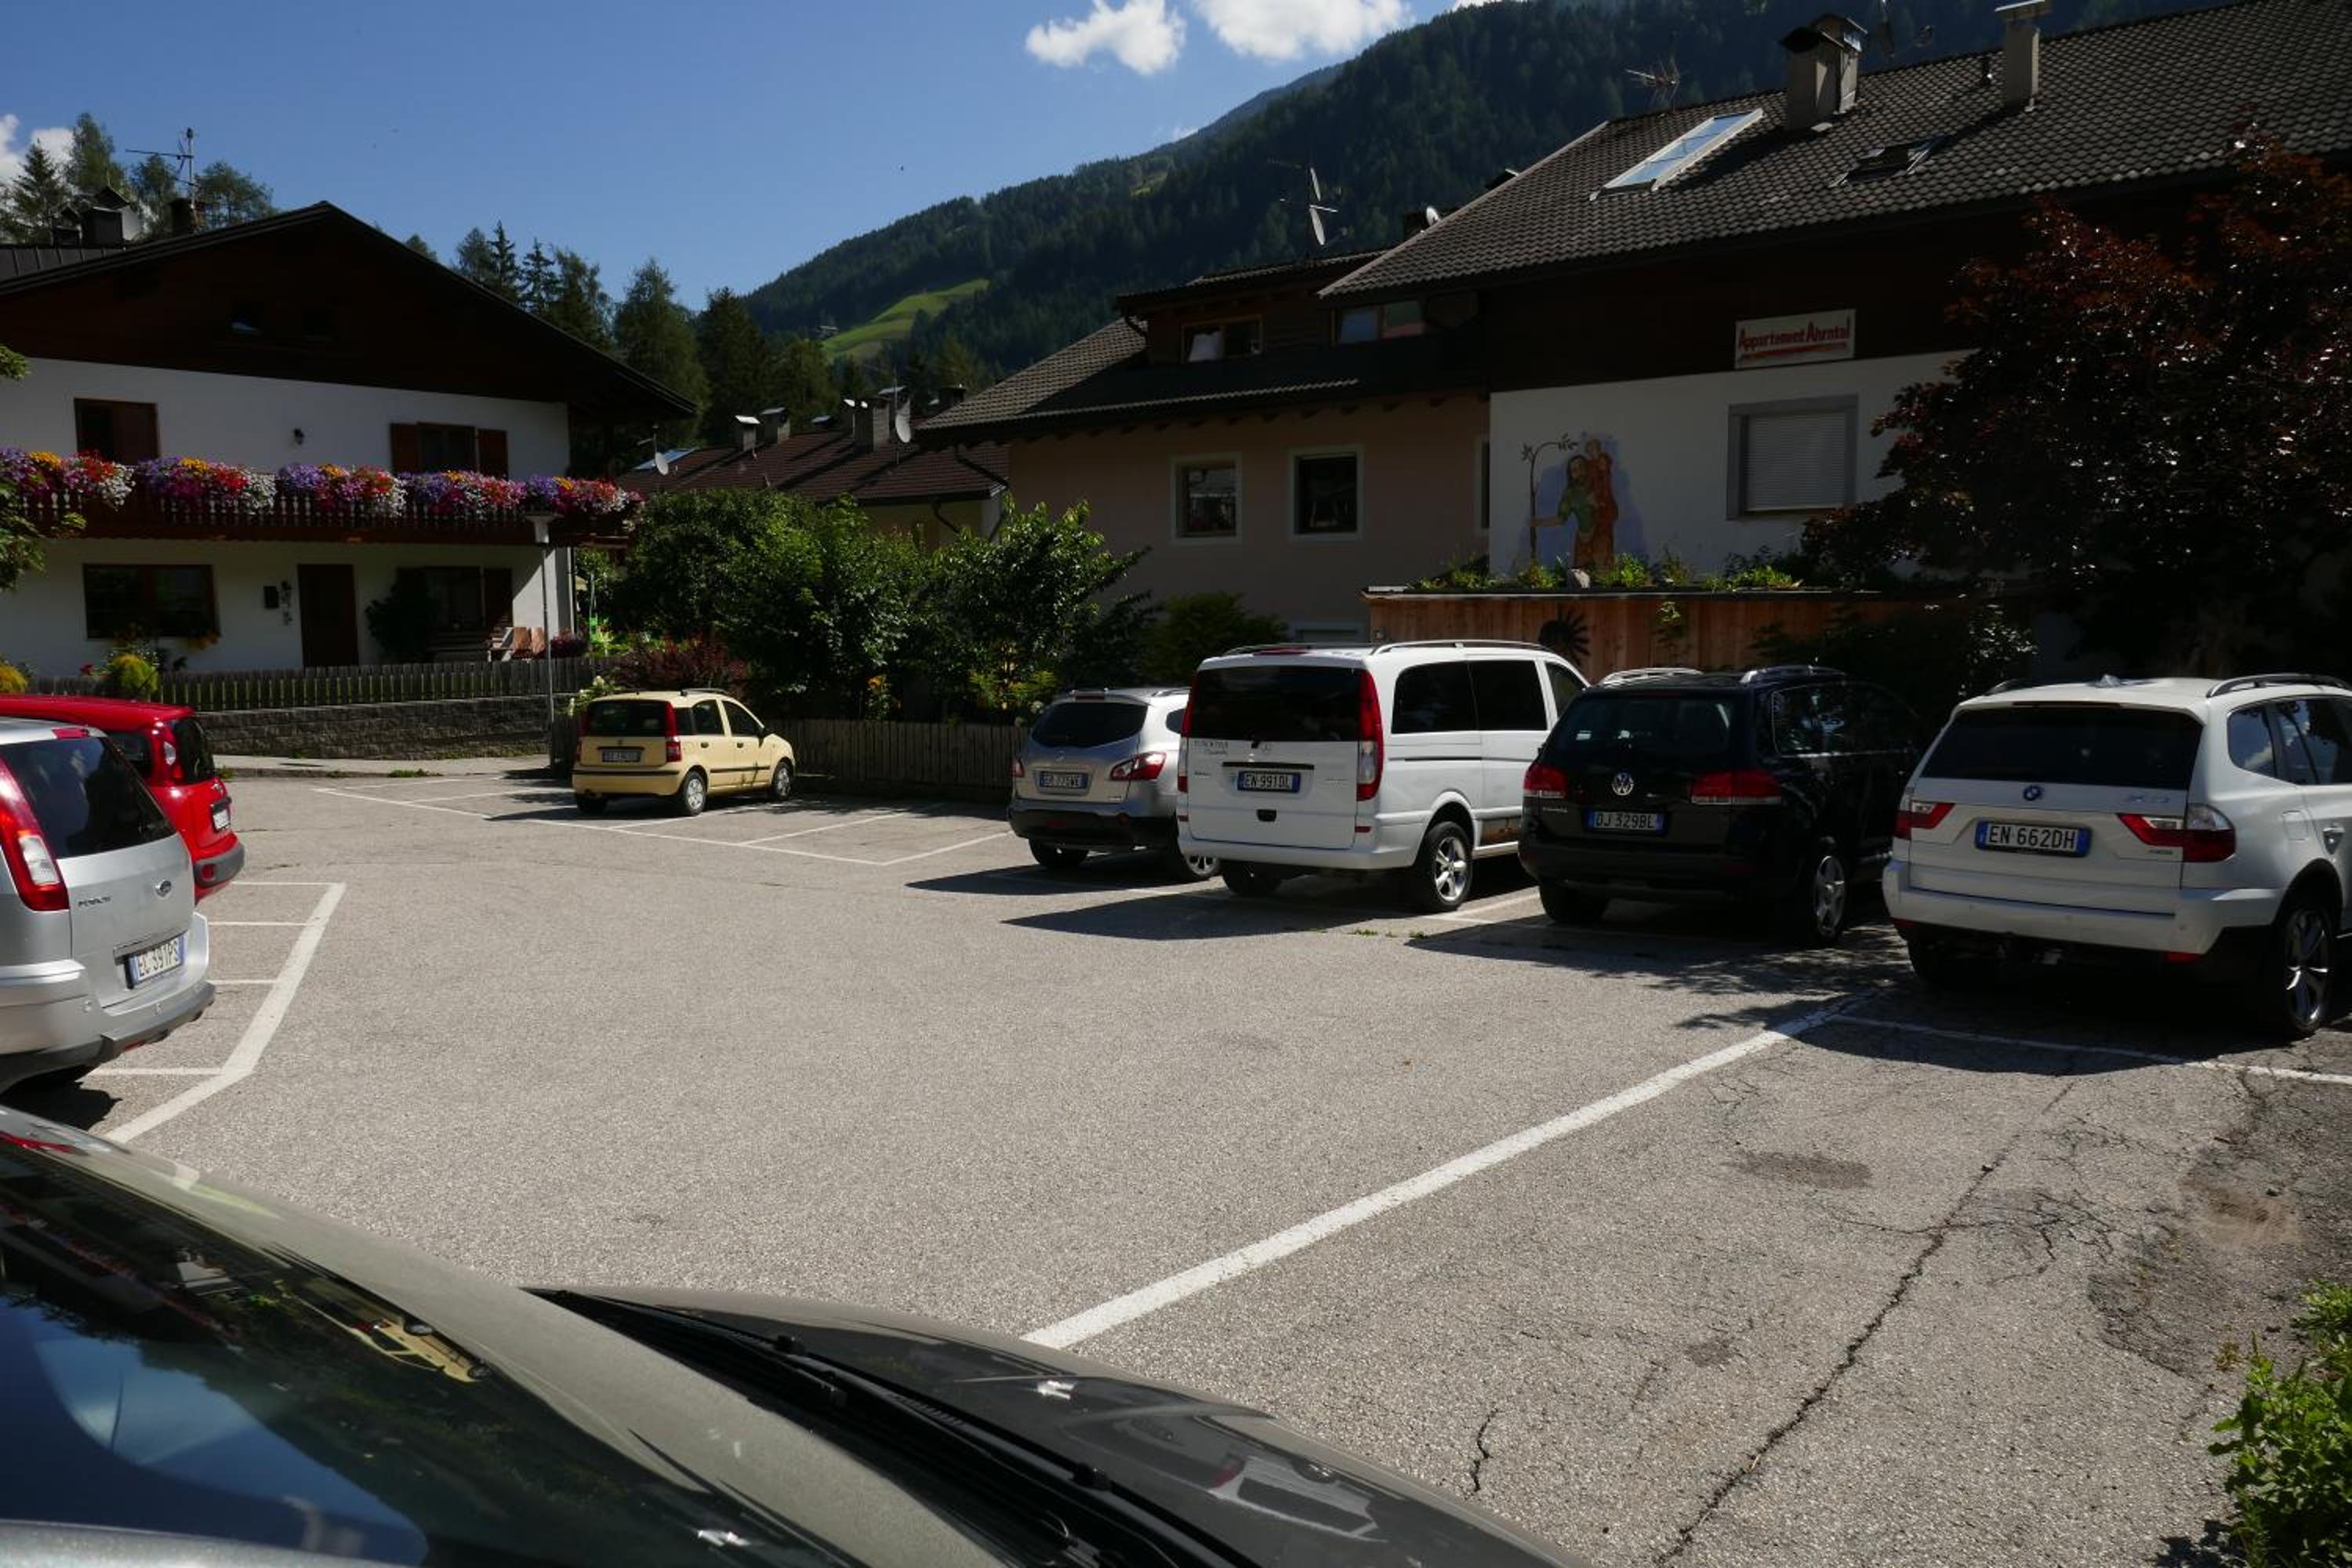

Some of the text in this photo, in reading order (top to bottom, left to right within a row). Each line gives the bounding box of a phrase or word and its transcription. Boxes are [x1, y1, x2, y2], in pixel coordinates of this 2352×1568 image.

[1806, 316, 1851, 342] Ahrntal
[1244, 774, 1257, 788] EN
[1614, 813, 1655, 829] 329BL
[1988, 825, 2076, 849] EN 662DH
